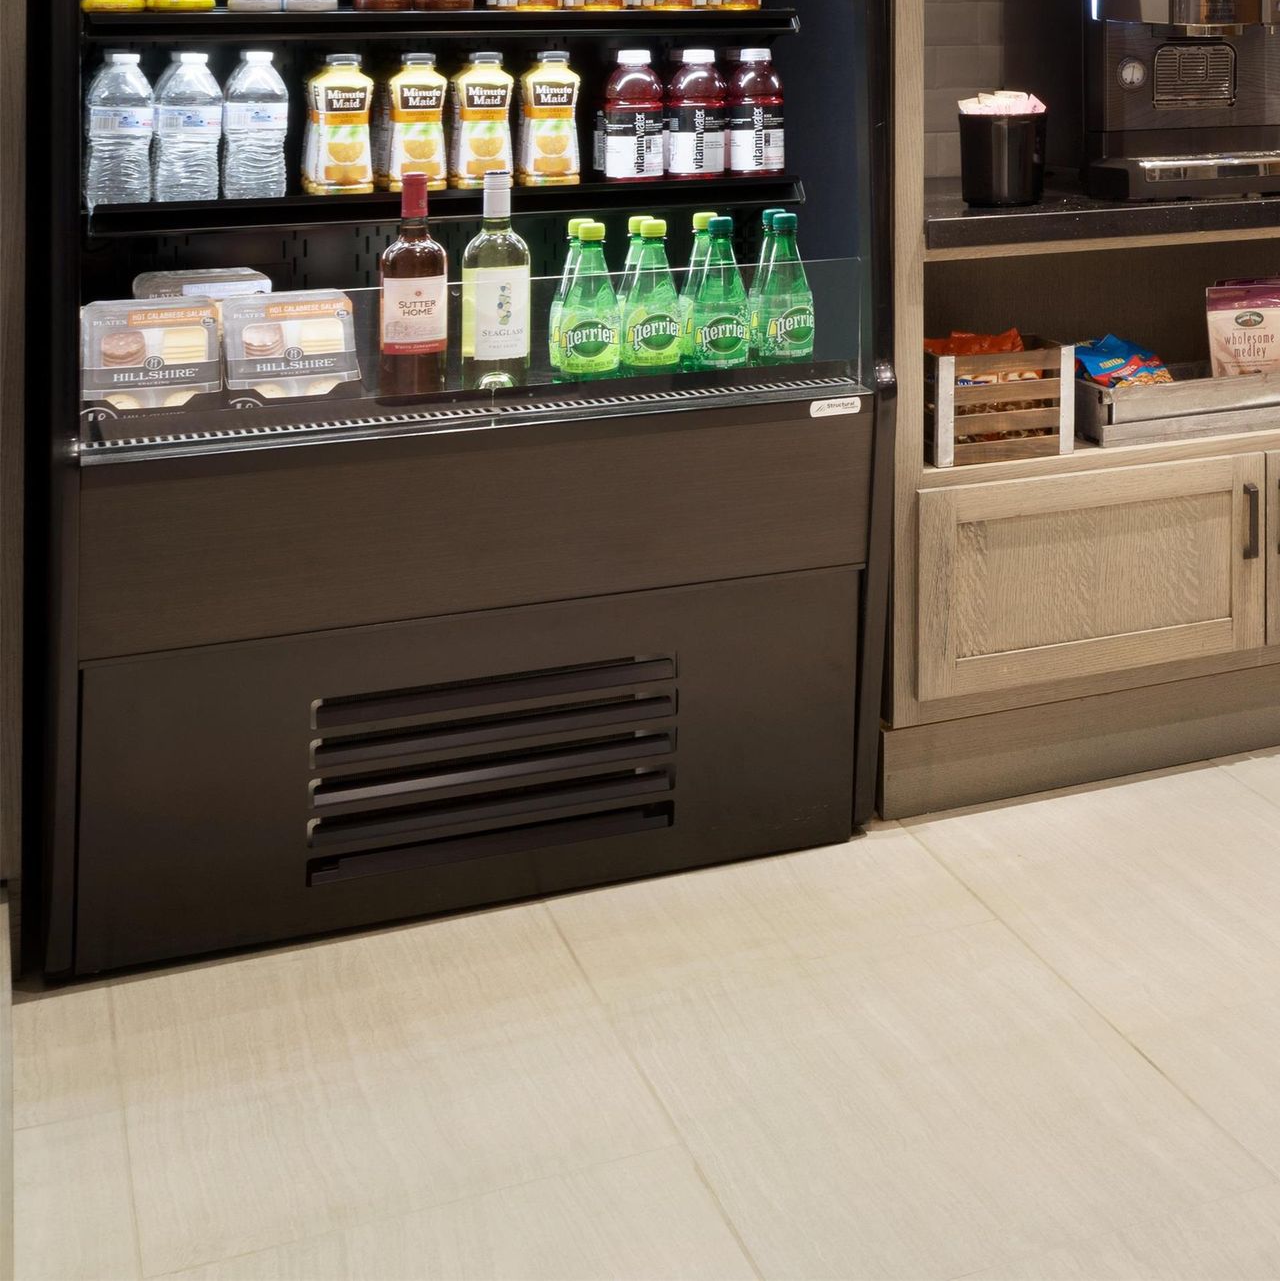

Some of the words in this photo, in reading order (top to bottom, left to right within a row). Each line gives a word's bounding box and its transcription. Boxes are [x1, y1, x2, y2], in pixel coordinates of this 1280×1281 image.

[327, 90, 366, 100] Minute
[403, 88, 441, 97] Minute
[468, 86, 506, 96] Minute
[535, 85, 573, 95] Minute
[332, 99, 361, 108] Maid
[408, 96, 437, 106] Maid
[473, 95, 502, 105] Maid
[539, 94, 568, 103] Maid
[693, 109, 704, 170] vitaminwater
[752, 106, 764, 167] vitaminwater
[634, 113, 646, 174] vitaminwater
[398, 300, 436, 309] SUTTER
[402, 308, 433, 317] HOME
[565, 327, 616, 358] perrier
[1224, 332, 1275, 345] wholesome
[1234, 345, 1266, 358] medley
[256, 358, 334, 372] HILLSHIRE
[113, 369, 195, 382] HILLSHIRE
